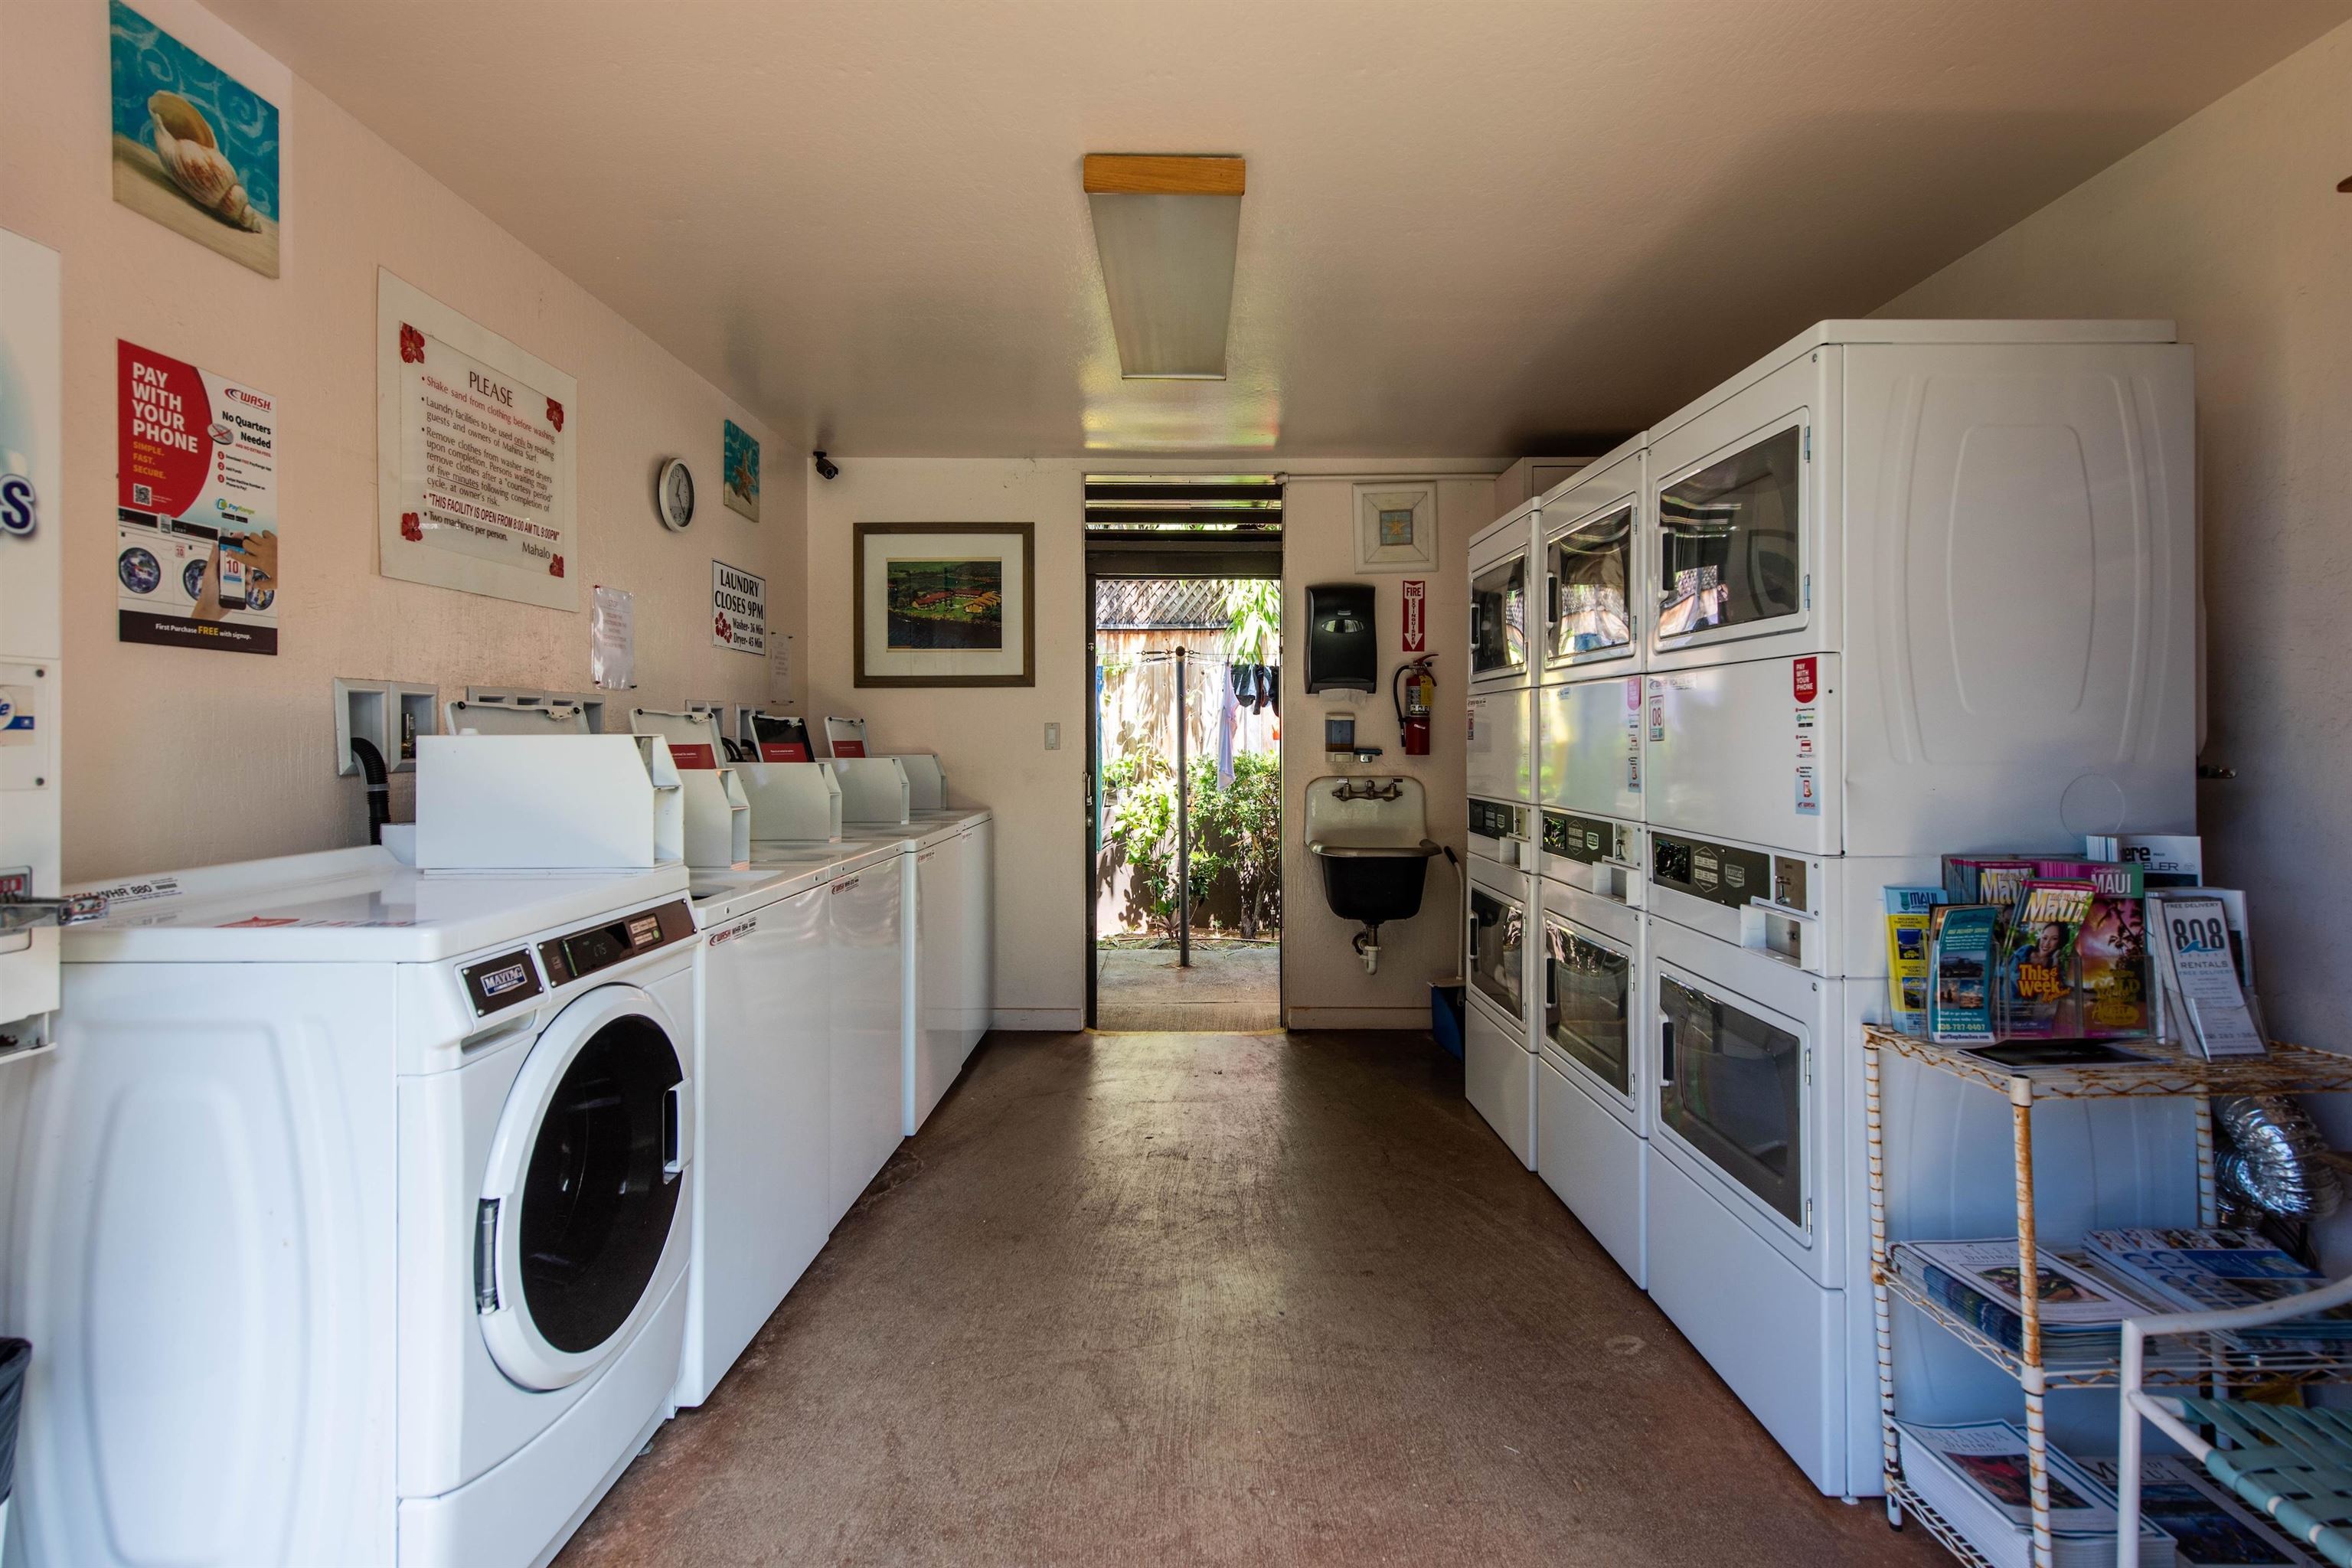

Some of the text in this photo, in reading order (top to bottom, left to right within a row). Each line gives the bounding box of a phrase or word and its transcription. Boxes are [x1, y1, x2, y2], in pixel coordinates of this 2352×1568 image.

[133, 361, 168, 388] PAY
[132, 381, 181, 413] WITH
[469, 371, 513, 408] PLEASE
[240, 391, 271, 410] WASH
[427, 376, 449, 394] Shake
[451, 388, 467, 403] sand
[469, 396, 485, 410] from
[487, 406, 511, 426] clothing
[513, 416, 532, 432] before
[132, 399, 185, 431] YOUR
[222, 410, 271, 436] No Quarters
[132, 419, 198, 453] PHONE
[426, 397, 554, 462] Laundry facilities to be used only by residing
[426, 412, 539, 464] guests and owners of Mahina Surf.
[133, 441, 165, 456] SIMPLE.
[240, 431, 271, 449] Needed
[133, 452, 155, 465] FAST.
[426, 426, 552, 484] Remove clothes from washer and dryers
[133, 465, 166, 479] SECURE.
[426, 440, 547, 492] upon completion. Persons waiting may
[426, 453, 453, 468] remove
[456, 461, 480, 476] clothes
[482, 471, 496, 482] after
[426, 465, 550, 513] of five minutes following completion of
[426, 476, 500, 508] cycle, at owner's risk.
[429, 492, 446, 509] "THIS
[447, 498, 473, 517] FACILITY
[474, 507, 480, 519] IS
[481, 509, 496, 526] OPEN
[498, 514, 513, 530] FROM
[513, 519, 524, 532] 8:00
[524, 523, 532, 534] AM
[429, 511, 508, 541] Two machines per person.
[176, 547, 184, 557] 10
[521, 541, 550, 560] Mahalo
[227, 560, 240, 574] 10
[720, 569, 760, 598] LAUNDRY
[1406, 586, 1422, 597] FIRE
[714, 590, 764, 620] CLOSES 9PM
[155, 623, 170, 632] First
[171, 625, 198, 635] Purchase
[198, 626, 219, 636] FREE
[732, 618, 750, 632] Washer-
[756, 624, 764, 635] Min
[733, 632, 749, 648] Dryer-
[754, 637, 763, 648] Min
[1796, 676, 1810, 684] YOUR
[1796, 682, 1813, 691] PHONE
[1652, 707, 1662, 727] 08
[97, 887, 129, 900] WHR
[130, 884, 152, 896] 880
[2091, 874, 2132, 893] MAUI
[2172, 917, 2225, 951] 808
[2018, 963, 2050, 982] This
[2180, 960, 2229, 969] RENTALS
[485, 967, 522, 988] MAYTAG
[2017, 978, 2060, 998] Week
